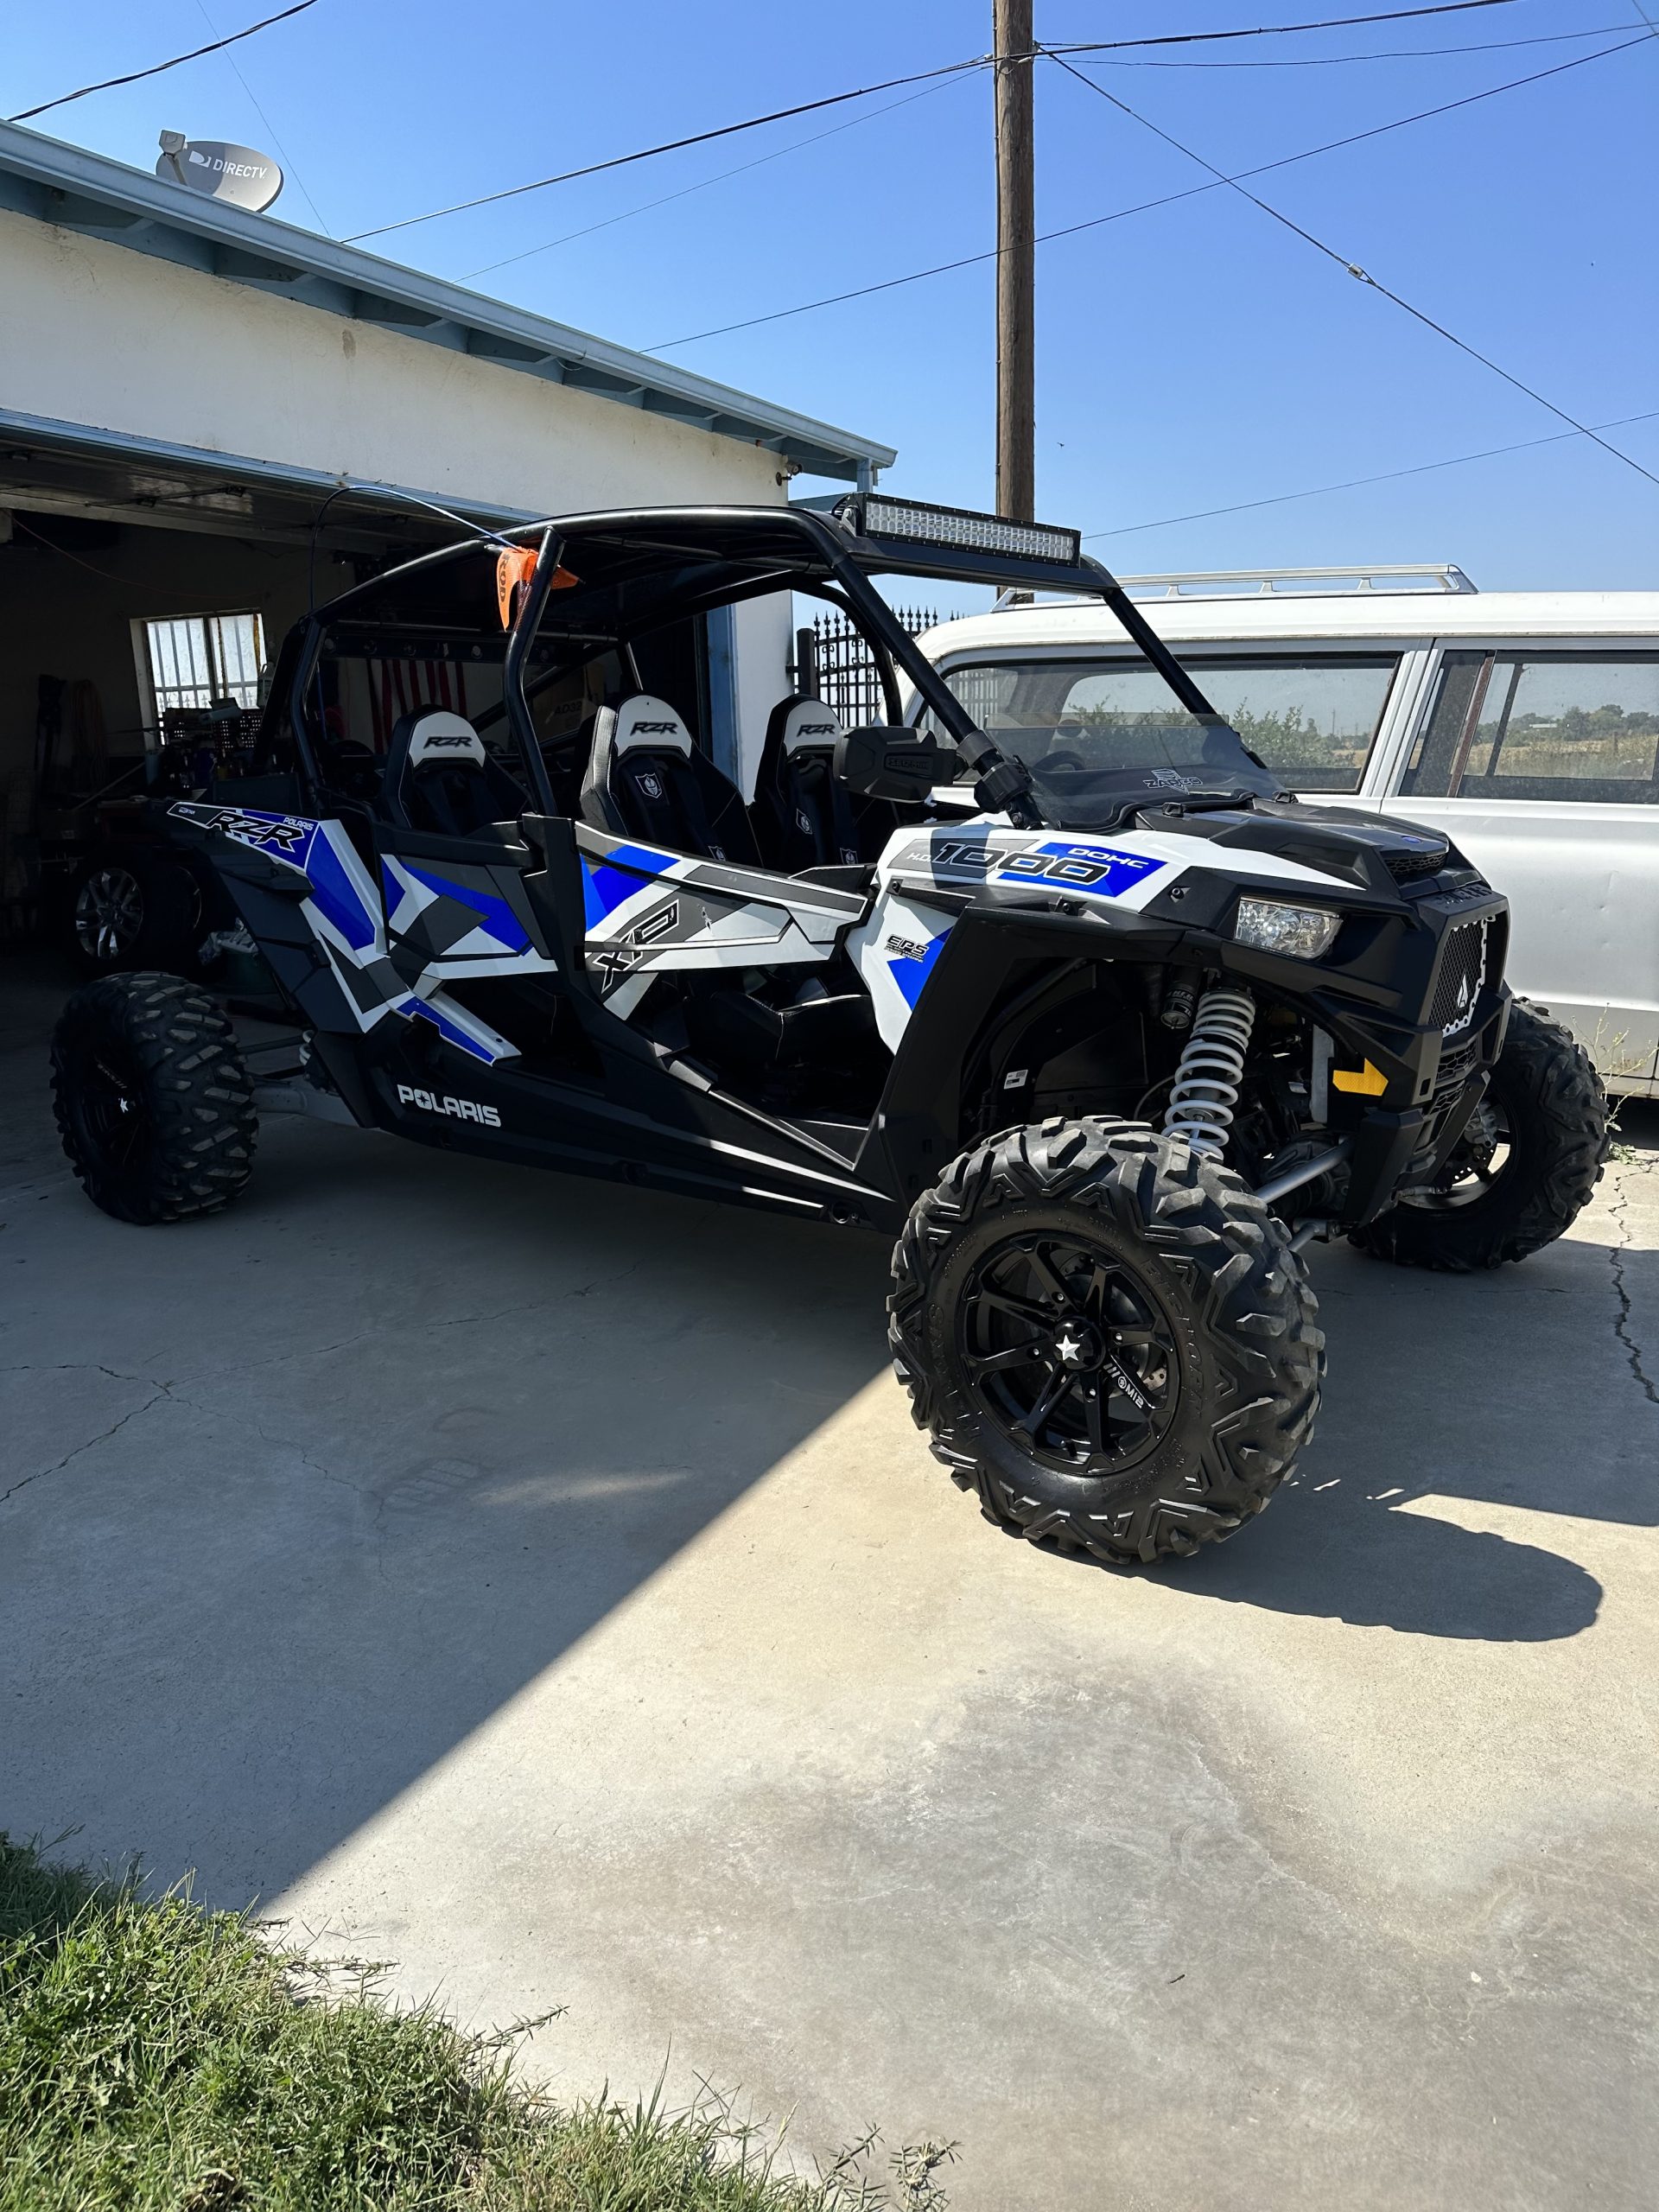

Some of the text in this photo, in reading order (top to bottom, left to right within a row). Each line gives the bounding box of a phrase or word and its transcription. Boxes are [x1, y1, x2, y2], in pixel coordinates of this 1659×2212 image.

[213, 158, 269, 179] DIRECTV
[630, 721, 678, 735] RZR
[796, 722, 836, 736] RZR
[423, 734, 473, 748] RZR
[206, 810, 306, 853] RZR
[283, 817, 315, 831] POLARIS
[931, 842, 1110, 886] 1000
[1067, 848, 1149, 869] DOHC
[592, 898, 679, 995] XP
[887, 934, 930, 957] EPS
[397, 1084, 501, 1128] POLARIS
